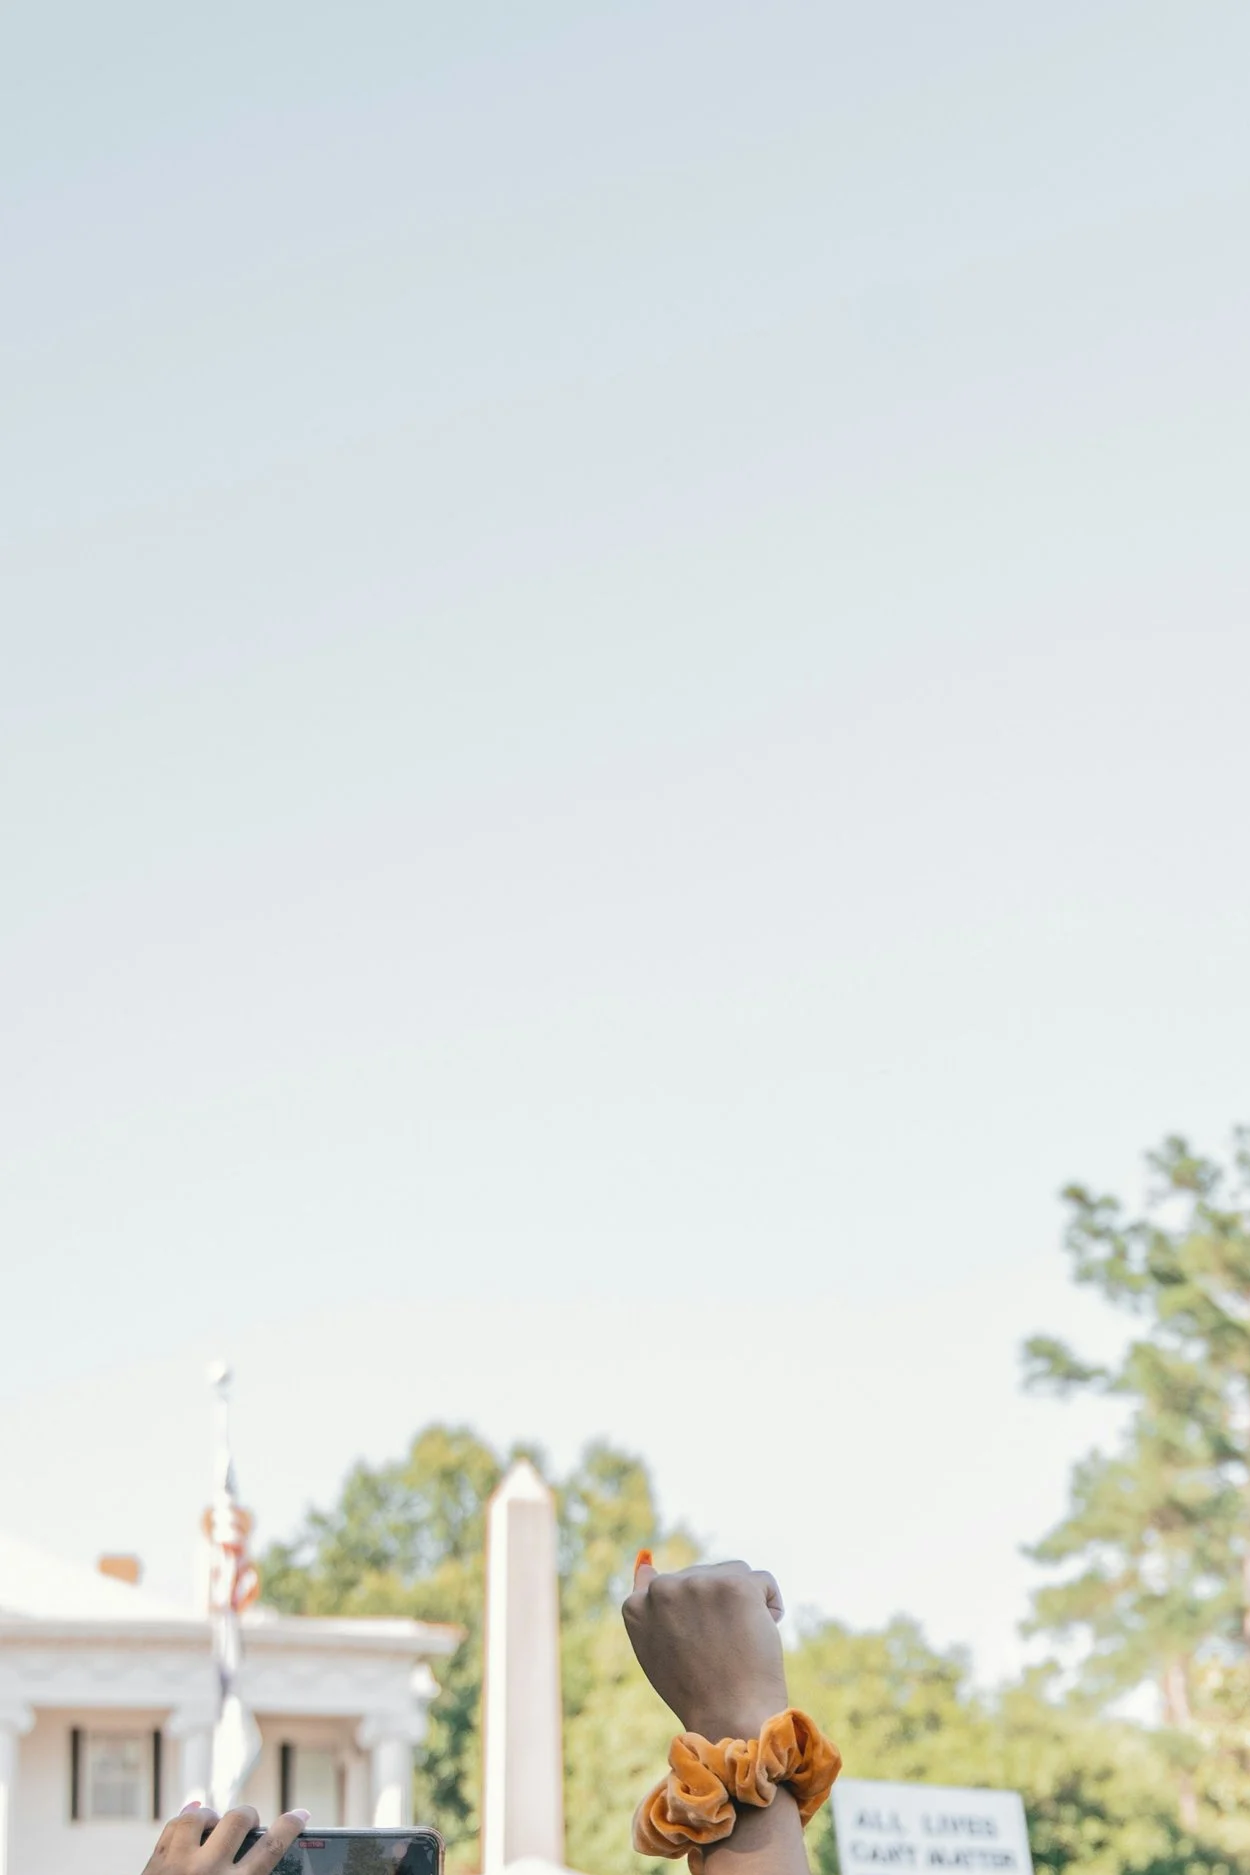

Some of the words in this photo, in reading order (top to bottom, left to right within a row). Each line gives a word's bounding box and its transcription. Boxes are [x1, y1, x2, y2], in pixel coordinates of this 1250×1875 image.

[855, 1810, 904, 1833] ALL
[923, 1815, 997, 1837] LIVES
[928, 1849, 1016, 1870] MATTER
